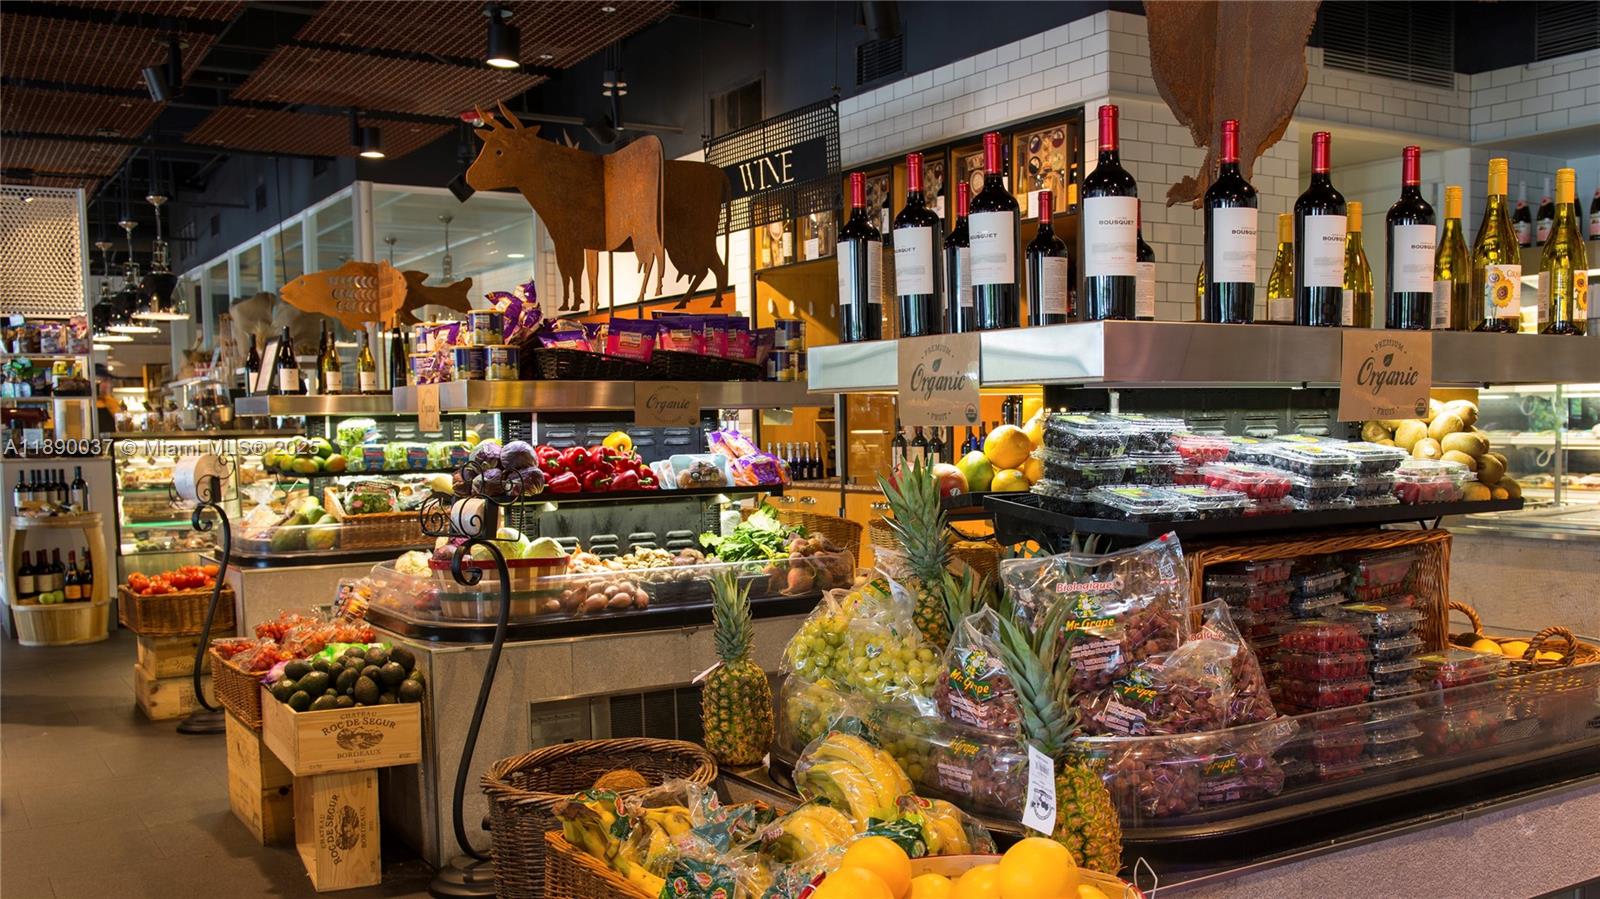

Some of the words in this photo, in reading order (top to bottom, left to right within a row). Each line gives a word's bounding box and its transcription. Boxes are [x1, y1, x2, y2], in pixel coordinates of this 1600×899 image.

[739, 150, 794, 192] WINE
[910, 363, 966, 401] Organic
[1356, 356, 1419, 396] Organic
[646, 394, 690, 416] Organic
[1056, 580, 1114, 593] Biologique
[1081, 618, 1115, 634] Grape
[322, 721, 344, 736] ROC
[346, 719, 360, 728] DE
[362, 717, 396, 729] SEGUR
[337, 749, 381, 759] BORDEAUX
[325, 794, 340, 827] SEGUR
[326, 828, 334, 843] DE
[328, 845, 342, 865] ROC
